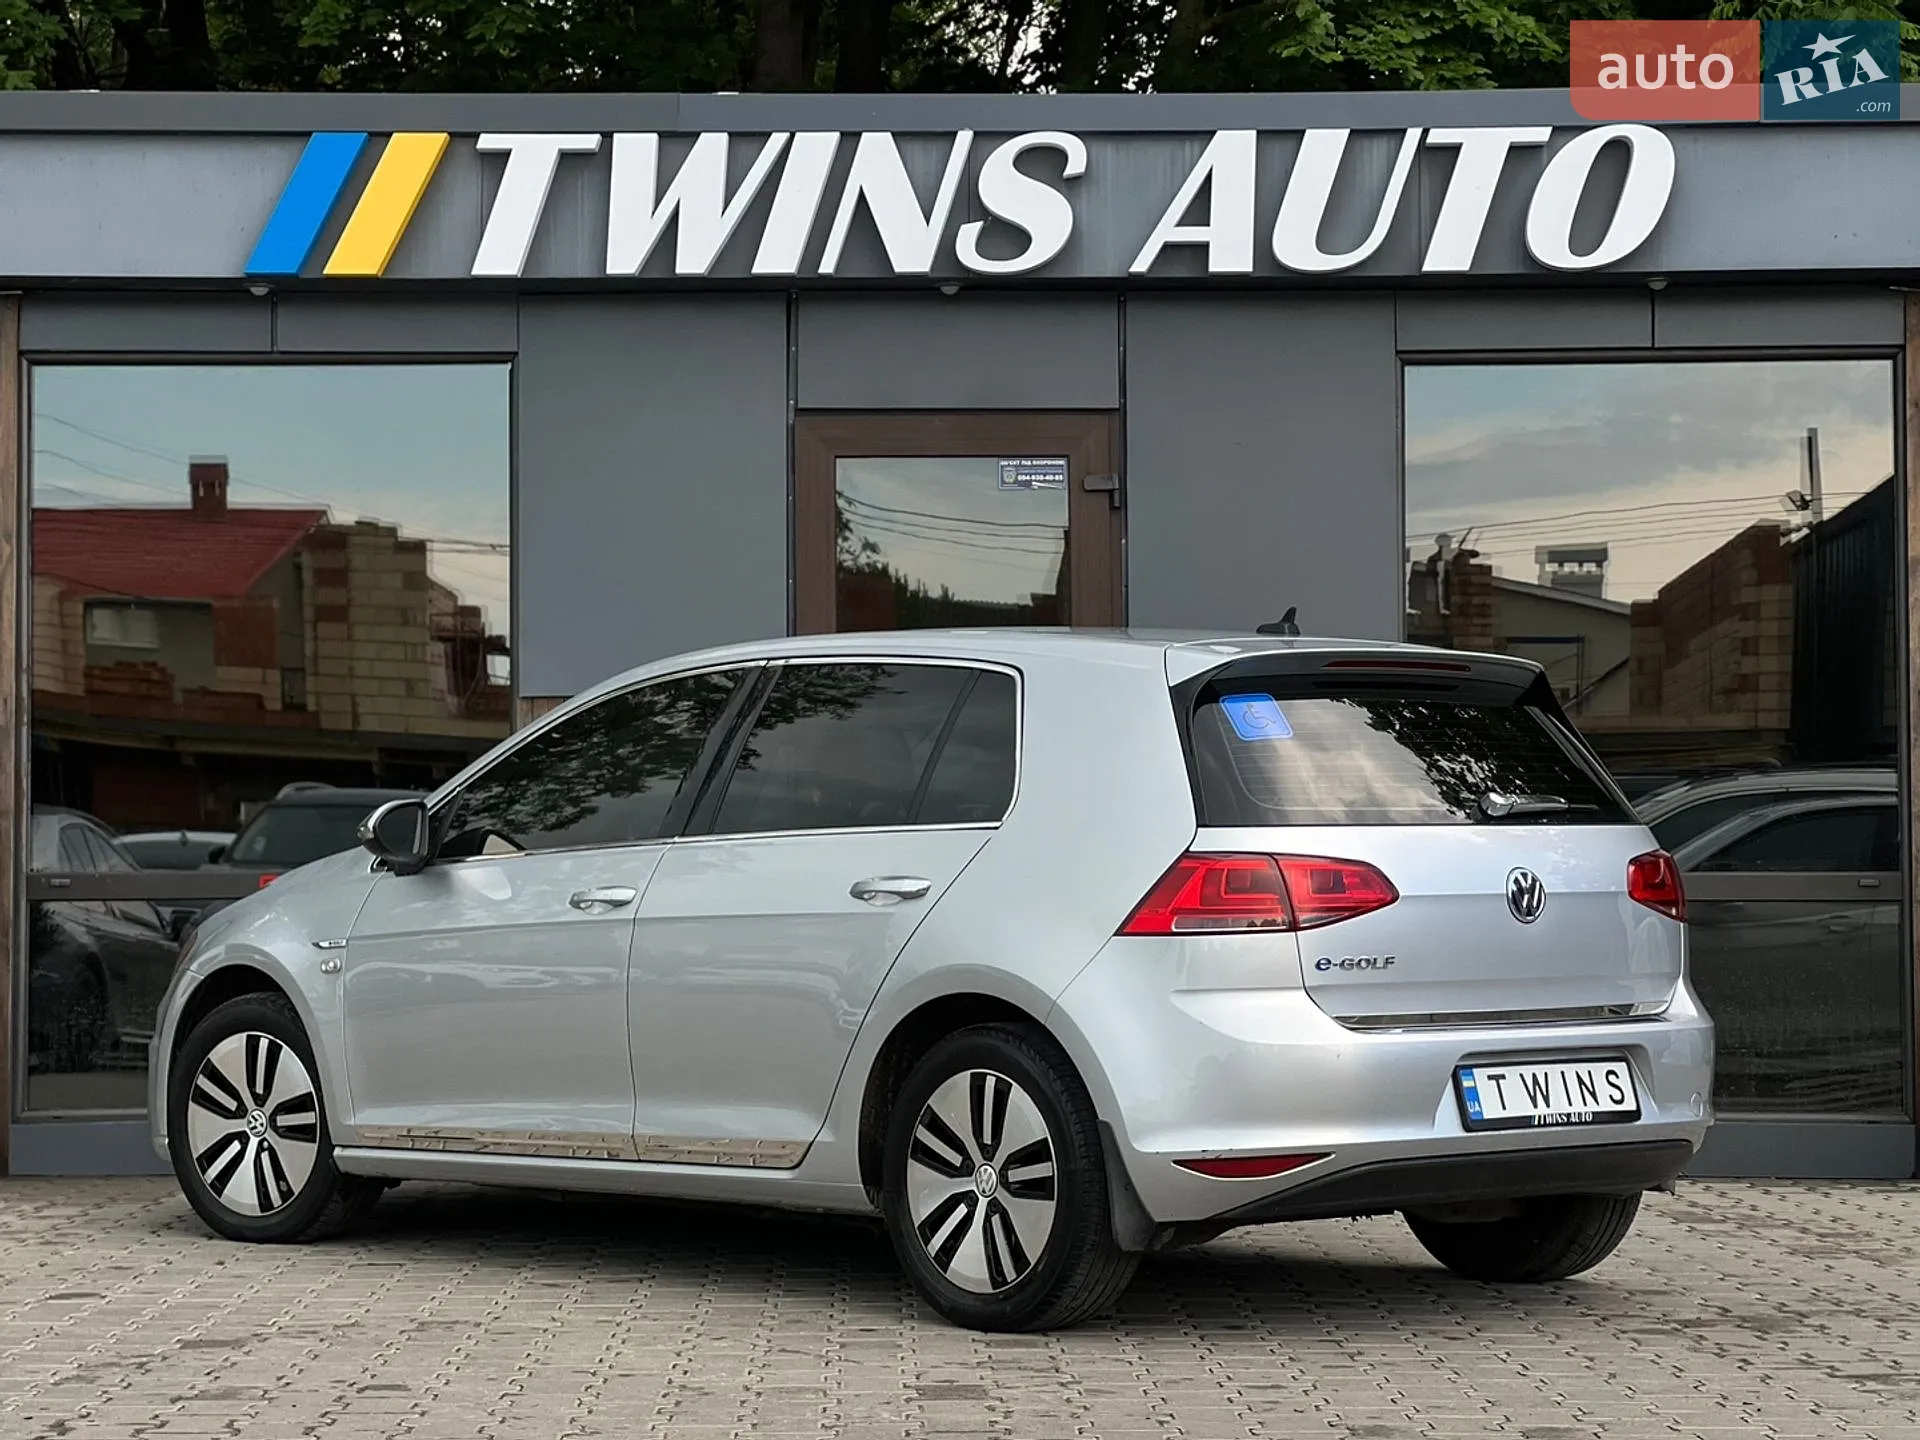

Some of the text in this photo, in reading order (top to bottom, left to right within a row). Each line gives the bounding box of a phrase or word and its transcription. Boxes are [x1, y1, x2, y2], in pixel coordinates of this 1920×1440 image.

[471, 123, 1676, 277] TWINS AUTO
[1314, 955, 1396, 971] e-GOLF
[1467, 1102, 1482, 1112] UA
[1540, 1111, 1593, 1125] TWINS AUTO
